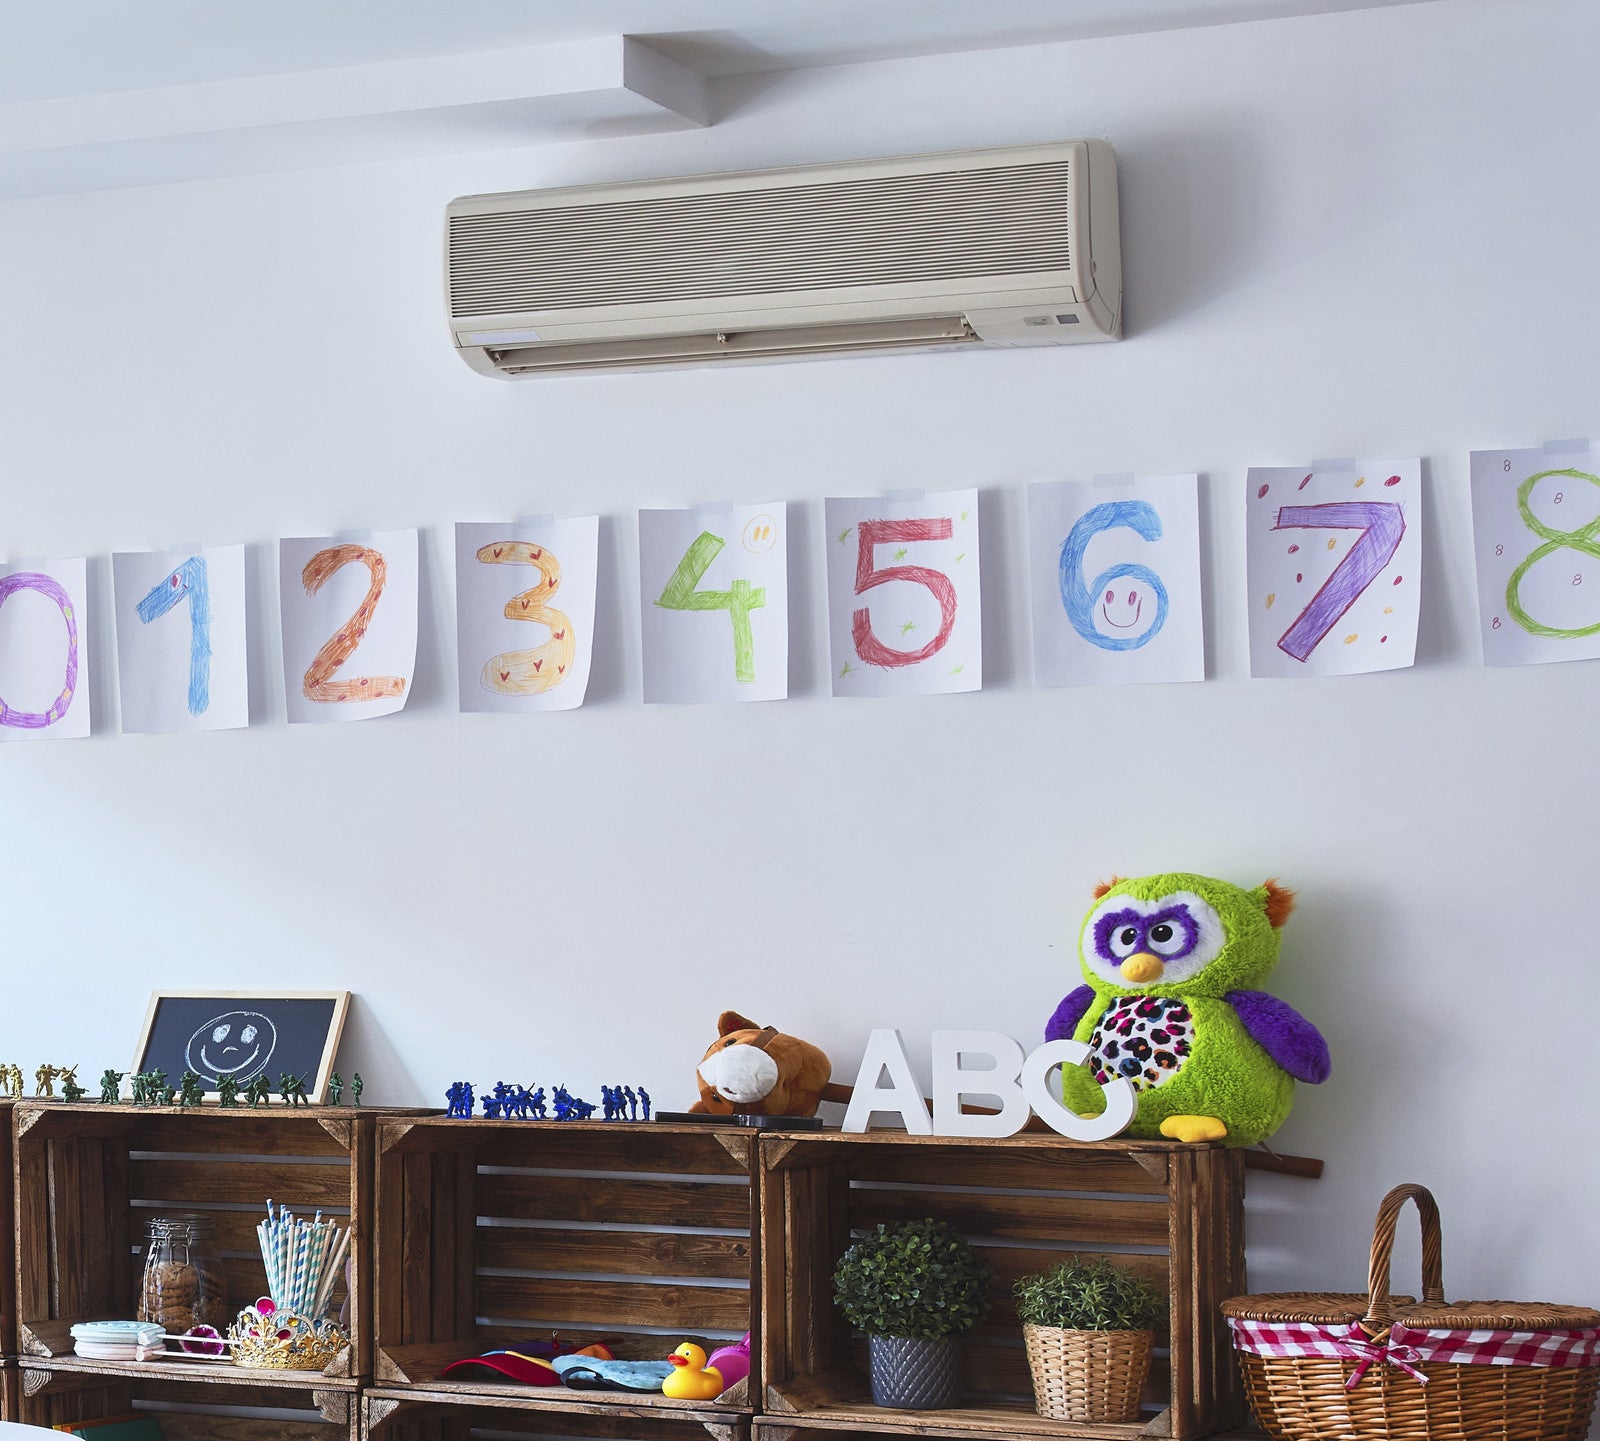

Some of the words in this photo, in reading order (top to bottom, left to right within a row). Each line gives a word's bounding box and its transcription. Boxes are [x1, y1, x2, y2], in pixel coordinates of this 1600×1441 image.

[300, 543, 407, 704] 2
[475, 541, 576, 697] 3
[653, 530, 767, 684] 4
[852, 516, 959, 670] 5
[1059, 499, 1169, 652] 6
[1268, 501, 1407, 664] 7
[1505, 467, 1600, 640] 8
[135, 555, 211, 719] 1
[841, 1028, 1137, 1142] ABC
